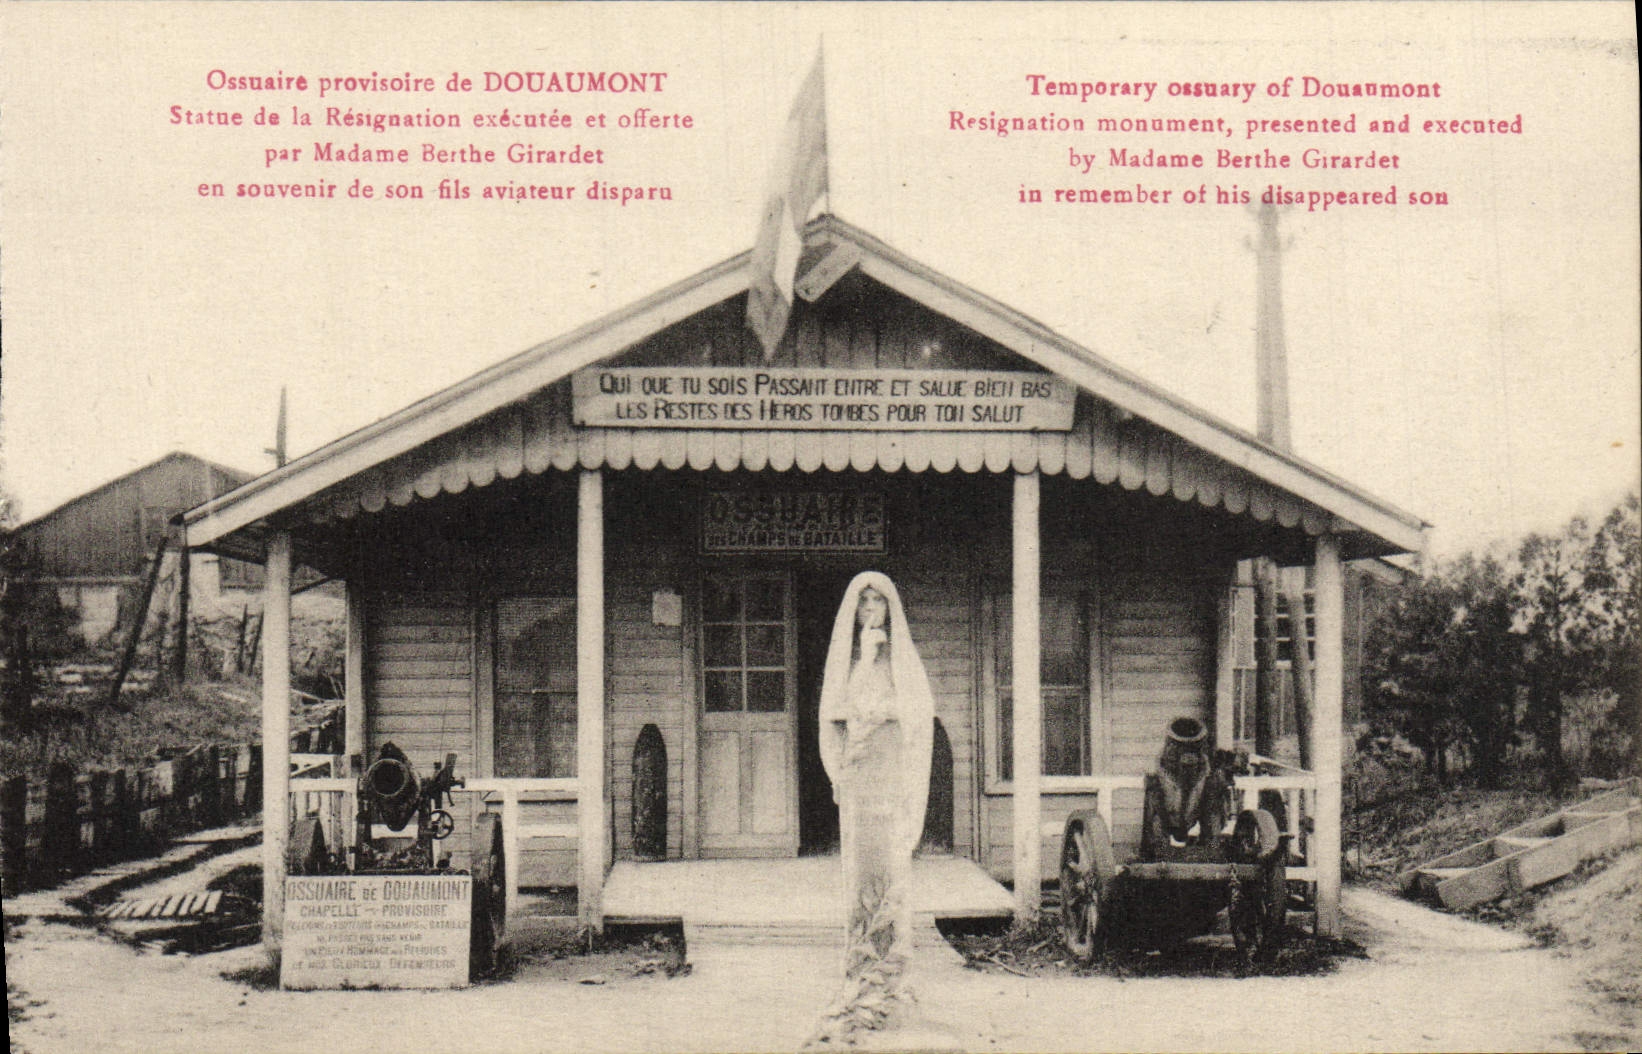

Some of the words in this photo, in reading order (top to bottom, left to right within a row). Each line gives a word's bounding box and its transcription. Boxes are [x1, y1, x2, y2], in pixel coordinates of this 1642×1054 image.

[600, 373, 631, 395] QUI
[642, 377, 672, 395] QUE
[681, 377, 700, 395] TU
[708, 376, 748, 395] SOIS
[755, 373, 828, 396] PASSANT
[835, 379, 884, 396] ENTRE
[890, 379, 911, 396] ET
[920, 379, 967, 397] SALUE
[974, 377, 1013, 397] BIEN
[1021, 381, 1052, 398] BAS
[617, 402, 647, 419] LES
[655, 399, 717, 420] RESTES
[724, 402, 752, 420] DES
[760, 399, 812, 421] HEROS
[821, 403, 879, 422] TOMBES
[887, 404, 926, 422] POUR
[935, 404, 964, 422] TON
[972, 405, 1024, 423] SALUT
[804, 530, 878, 547] BATAILLE
[287, 881, 357, 901] OSSUAIRE
[383, 880, 469, 901] DOUAUMONT
[382, 904, 448, 917] PROVISOIRE
